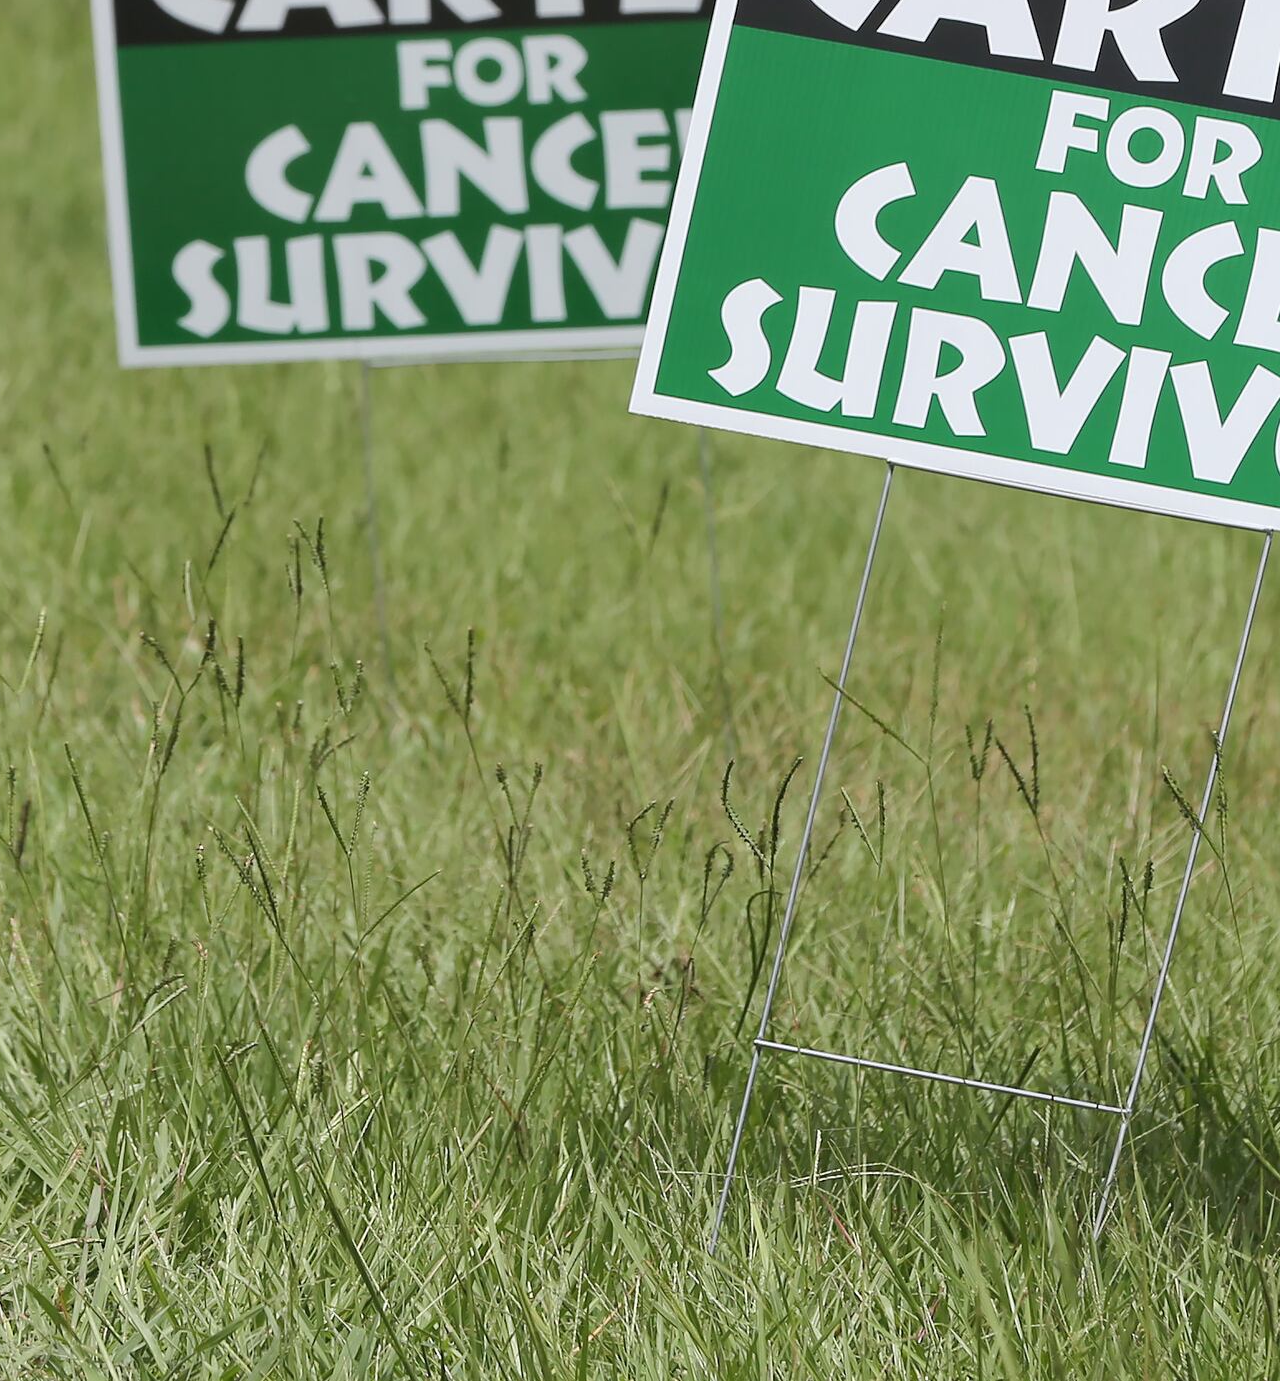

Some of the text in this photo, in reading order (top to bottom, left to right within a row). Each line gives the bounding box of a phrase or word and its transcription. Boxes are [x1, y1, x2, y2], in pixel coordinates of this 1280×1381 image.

[398, 35, 588, 110] FOR
[246, 108, 692, 223] CANCE
[1035, 89, 1262, 205] FOR
[172, 218, 663, 339] SURVIV
